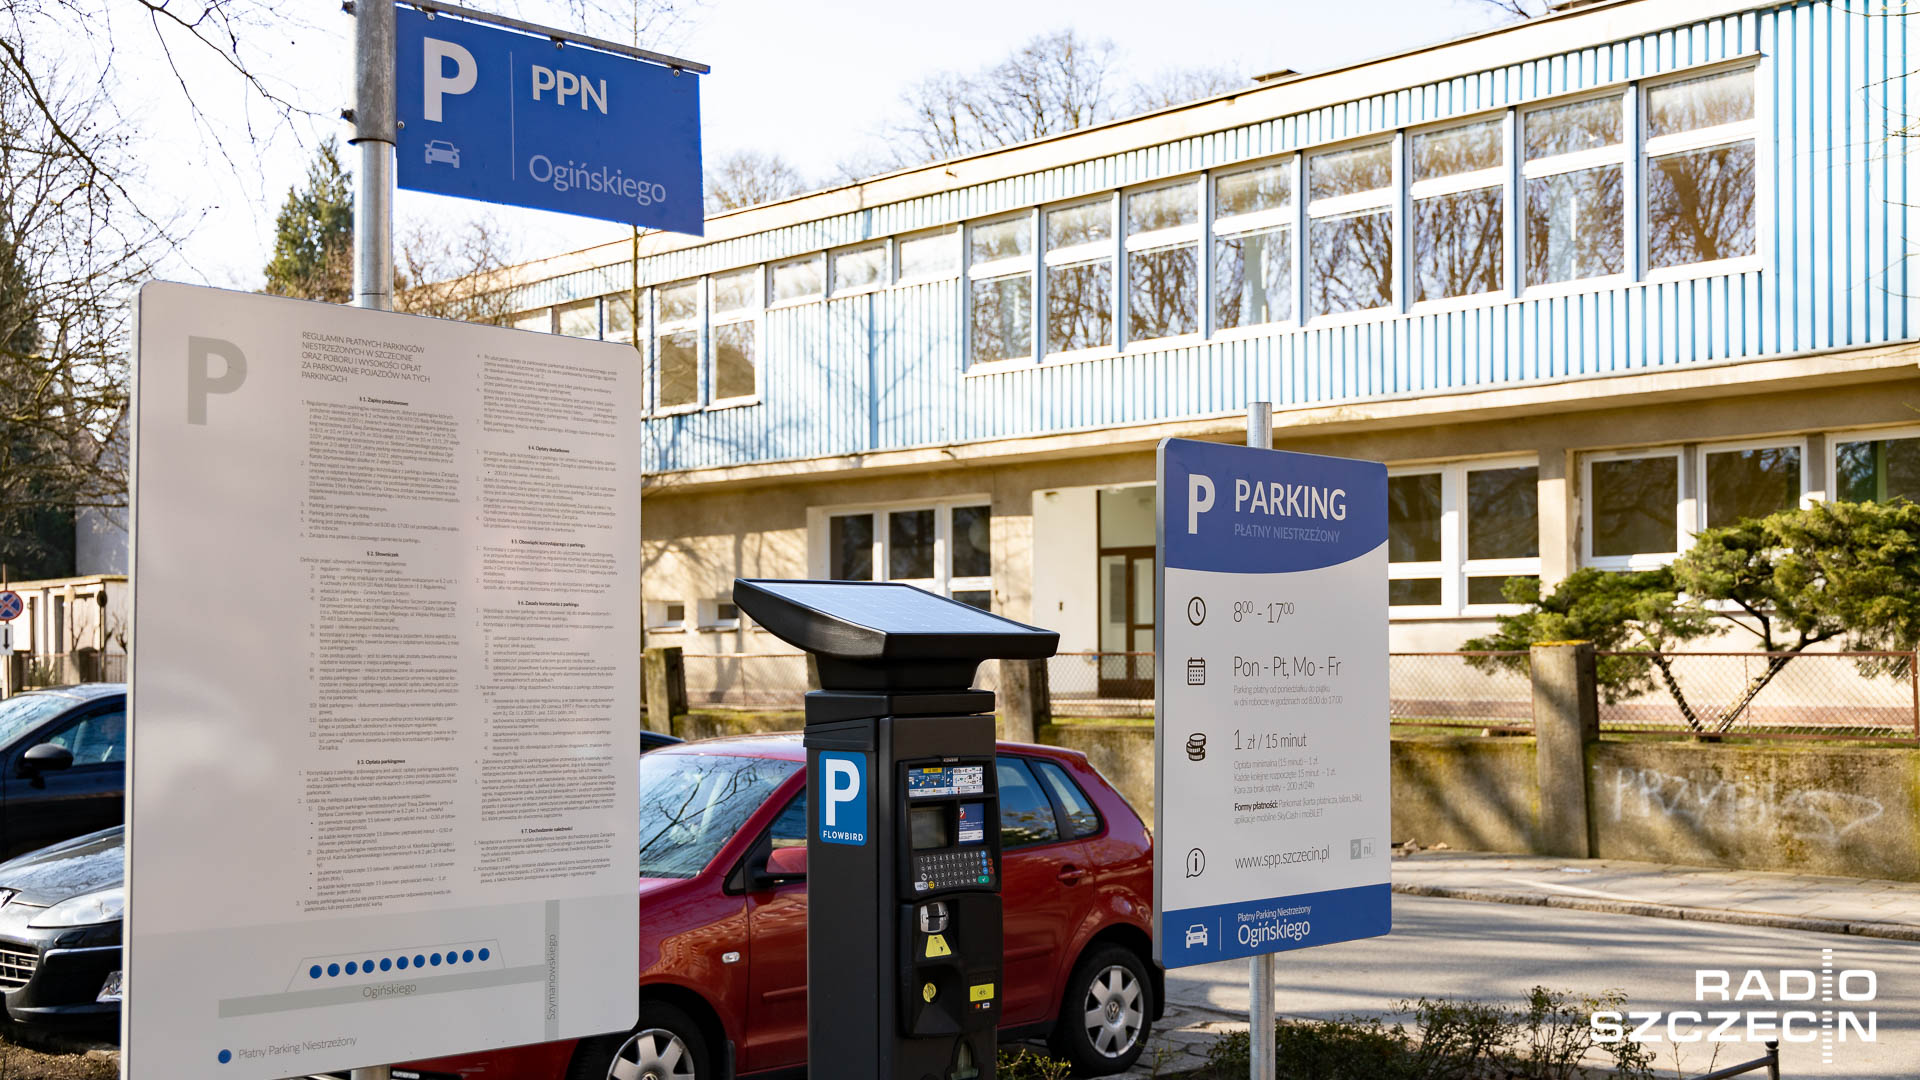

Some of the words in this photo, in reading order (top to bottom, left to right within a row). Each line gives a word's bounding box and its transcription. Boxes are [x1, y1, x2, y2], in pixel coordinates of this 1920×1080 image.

[424, 37, 478, 123] P
[532, 64, 607, 115] PPN
[529, 155, 666, 206] Ogińskiego
[303, 331, 344, 344] REGULAMIN
[346, 337, 382, 349] PŁATNYCH
[383, 342, 425, 354] PARKINGÓW
[303, 341, 365, 356] NIESTRZEŻONYCH
[366, 349, 374, 357] W
[375, 350, 413, 362] SZCZECINIE
[302, 351, 322, 360] ORAZ
[324, 354, 353, 364] POBORU
[359, 358, 399, 370] WYSOKOŚCI
[401, 363, 422, 373] OPŁAT
[302, 361, 311, 369] ZA
[313, 362, 359, 375] PARKOWANIE
[361, 368, 400, 380] POJAZDÓW
[401, 373, 411, 381] NA
[412, 374, 430, 383] TYCH
[187, 336, 247, 425] P
[302, 371, 348, 383] PARKINGACH
[1188, 474, 1215, 534] P
[1236, 479, 1346, 520] PARKING
[1235, 523, 1271, 538] PŁATNY
[1274, 527, 1340, 543] NIESTRZEŻONY
[1234, 656, 1259, 676] Pon
[1274, 656, 1289, 679] Pt,
[1294, 657, 1315, 676] Mo
[1328, 656, 1341, 676] Fr
[1234, 686, 1252, 695] Parking
[1253, 685, 1269, 694] płatny
[1278, 684, 1308, 694] poniedziałku
[1308, 684, 1316, 692] do
[1240, 698, 1248, 706] dni
[1276, 697, 1301, 707] godzinach
[1302, 696, 1308, 704] od
[1321, 696, 1327, 704] do
[1234, 729, 1242, 750] 1
[1247, 736, 1255, 750] zł
[1258, 734, 1263, 750] /
[1266, 734, 1278, 748] 15
[1280, 733, 1307, 748] minut
[1298, 769, 1304, 778] 15
[826, 758, 860, 826] P
[1254, 784, 1265, 793] brak
[1287, 782, 1298, 791] 200
[1235, 801, 1252, 813] Formy
[1253, 799, 1278, 812] płatności:
[823, 830, 864, 841] FLOWBIRD
[1235, 844, 1329, 869] www.spp.szczecin.pl
[1238, 913, 1255, 923] Płatny
[1256, 909, 1277, 920] Parking
[1278, 906, 1311, 917] Niestrzeżony
[1238, 919, 1310, 949] Ogińskiego
[547, 934, 556, 1020] Szymanowskiego
[363, 982, 417, 998] Ogińskiego
[238, 1047, 266, 1060] Płatny
[269, 1042, 300, 1056] Parking
[302, 1035, 357, 1052] Niestrzeżony
